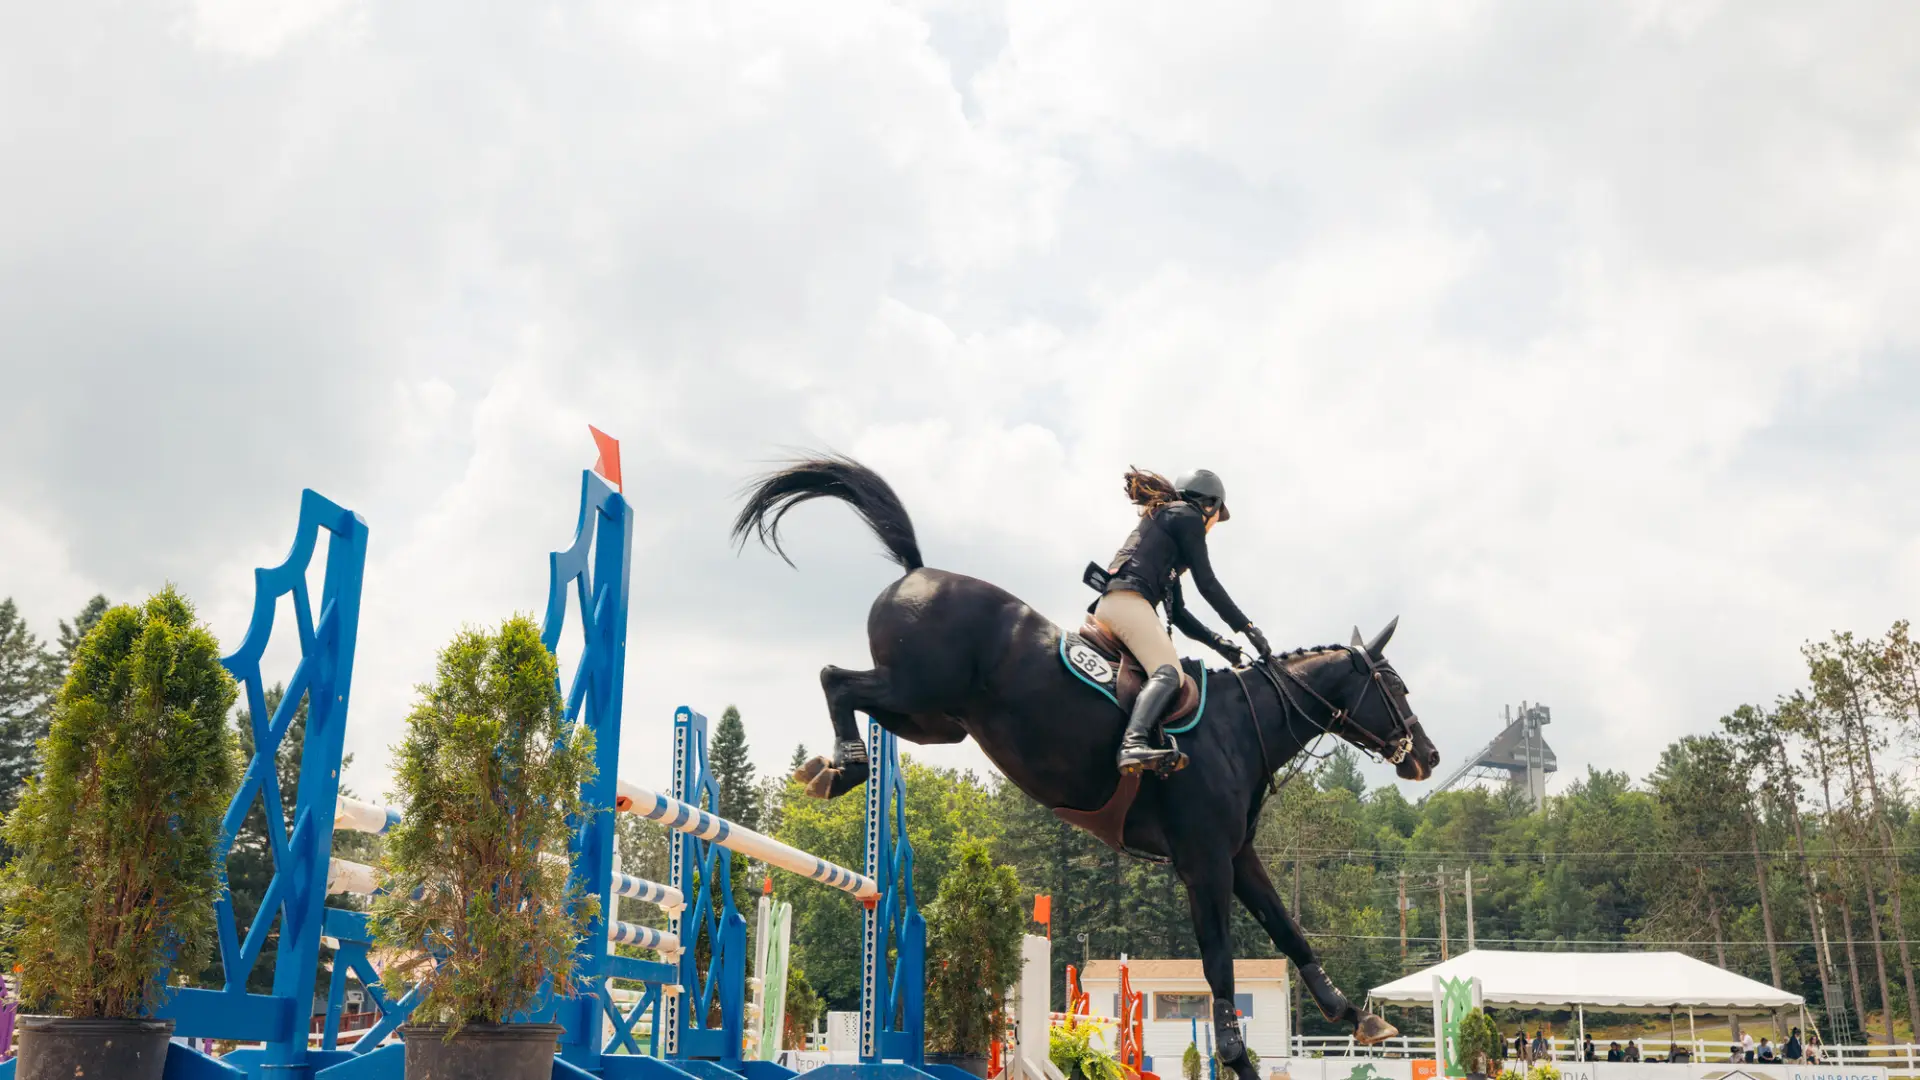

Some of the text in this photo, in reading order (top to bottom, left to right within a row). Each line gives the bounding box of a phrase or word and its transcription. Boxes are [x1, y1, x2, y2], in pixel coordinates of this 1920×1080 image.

[1073, 650, 1108, 677] 587
[800, 1059, 826, 1070] EDIA
[1562, 1072, 1589, 1080] DIA
